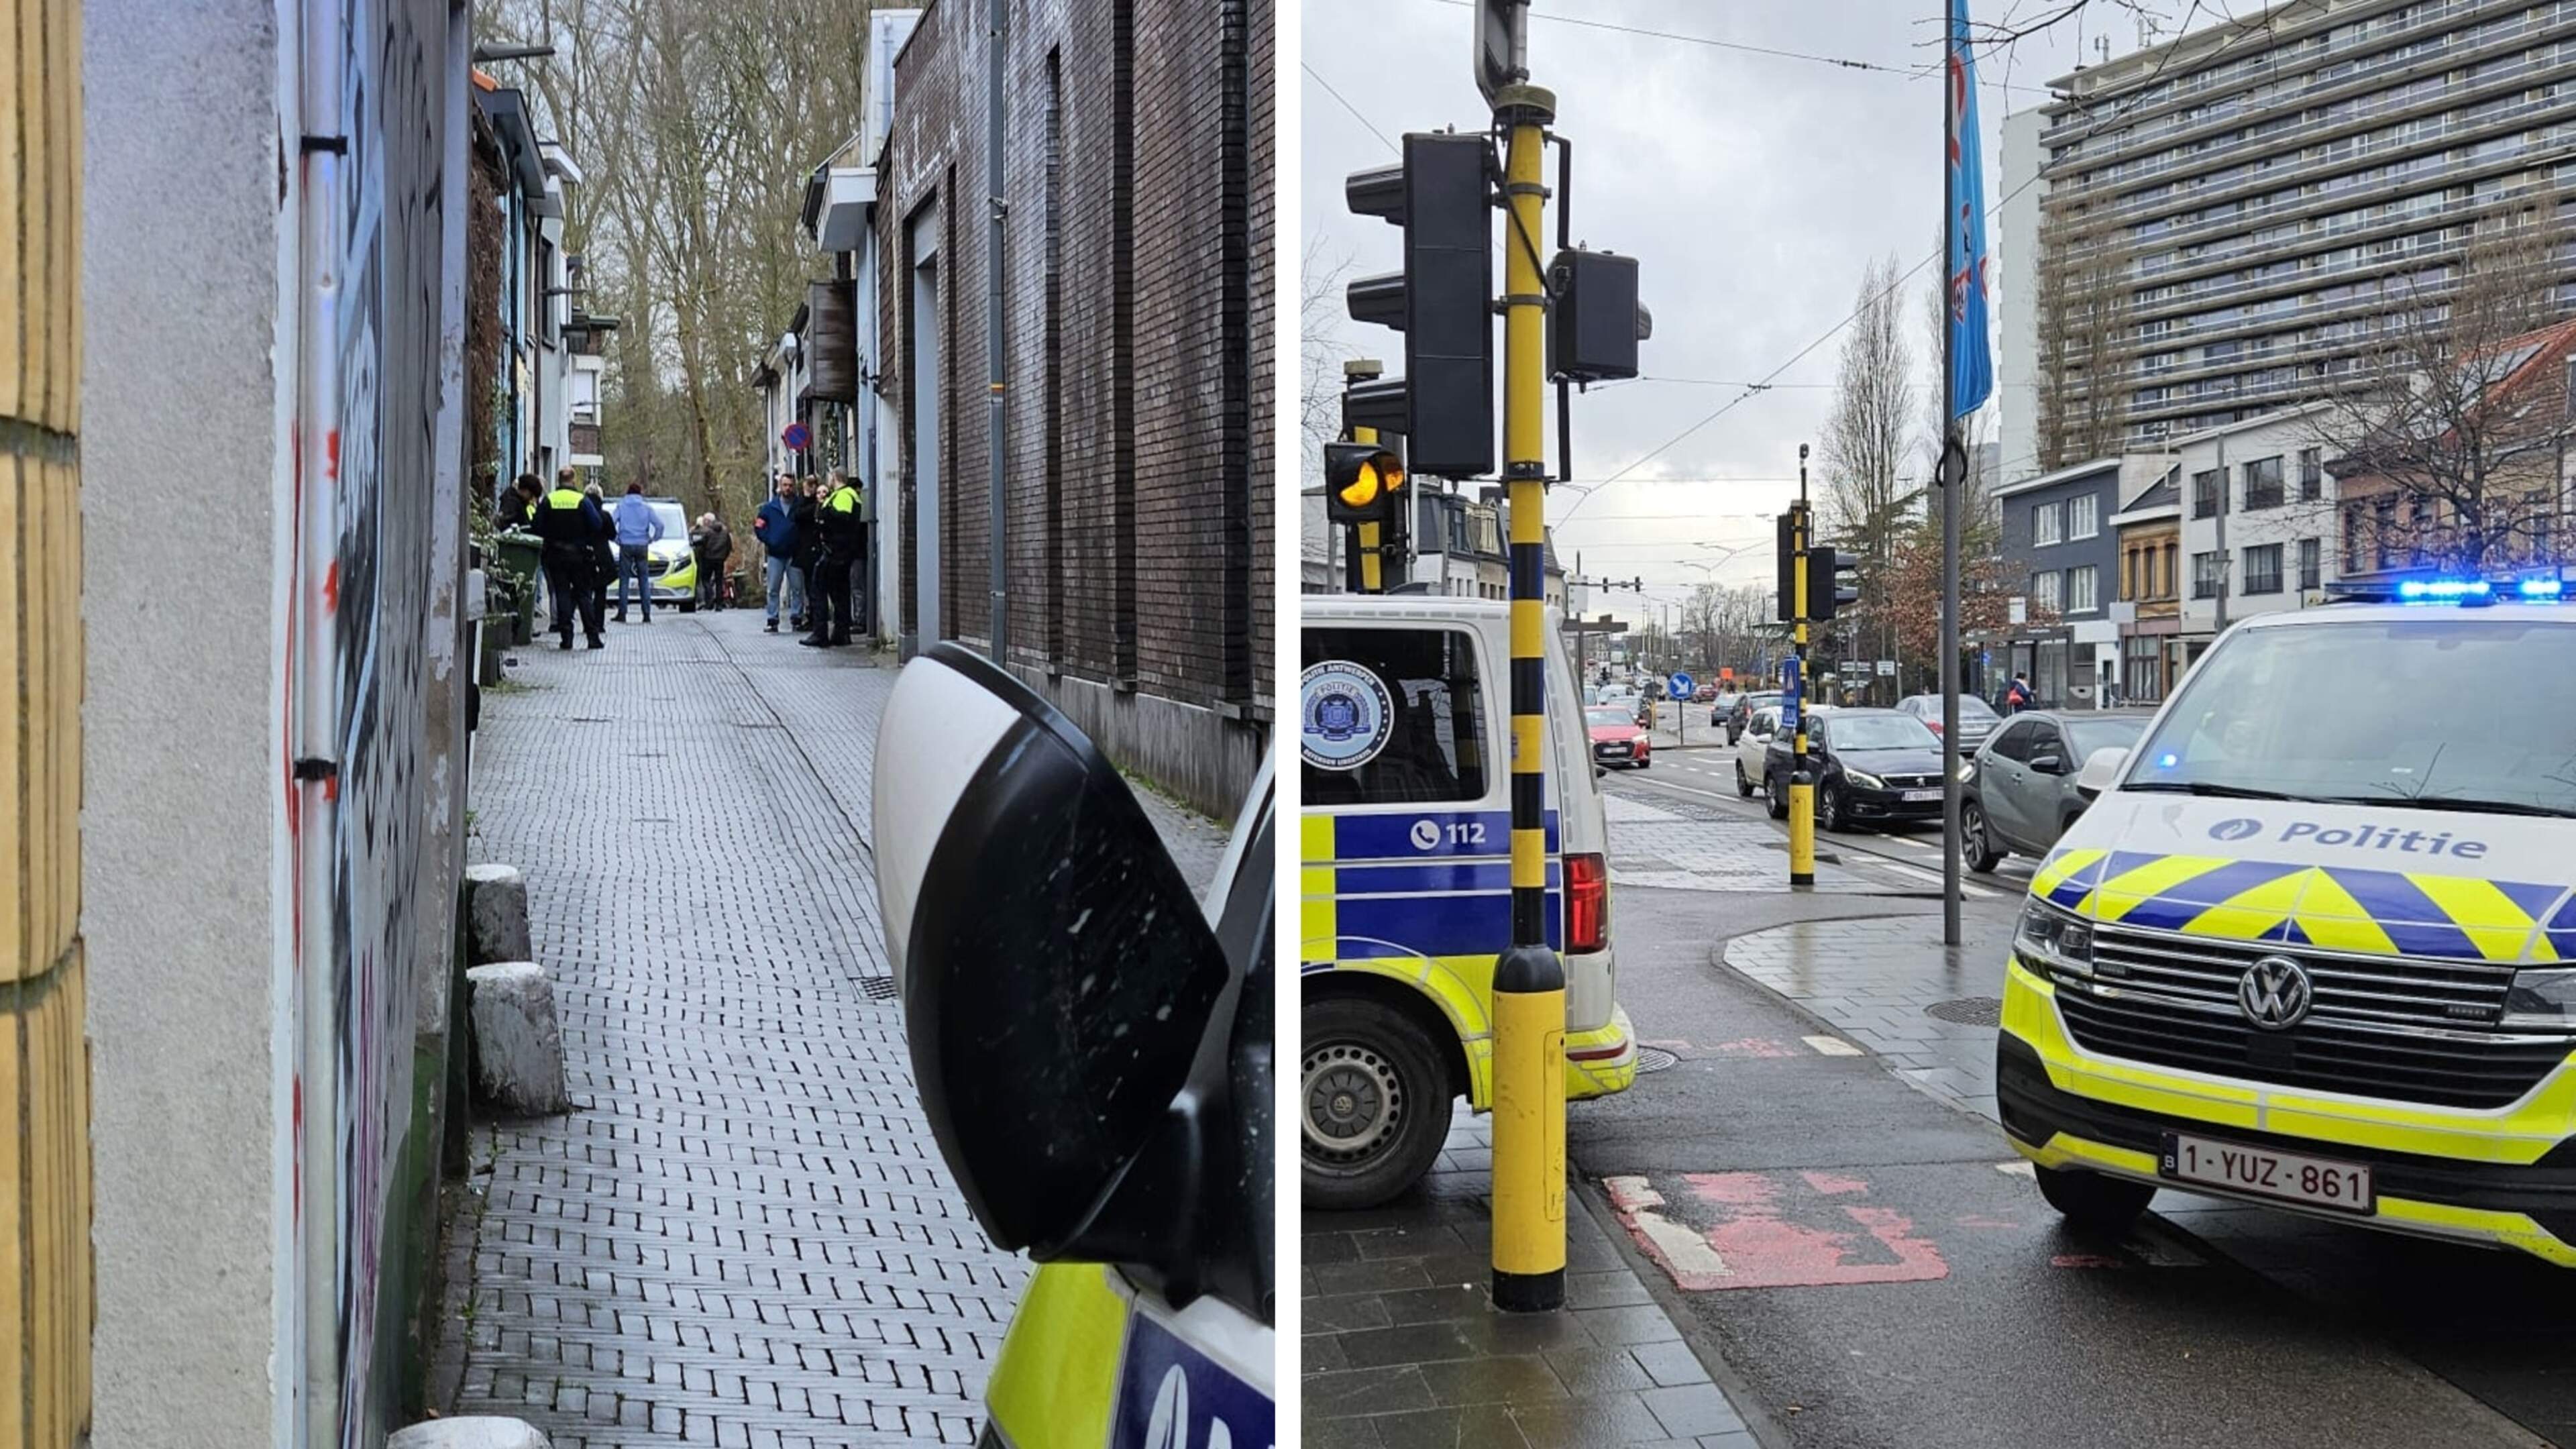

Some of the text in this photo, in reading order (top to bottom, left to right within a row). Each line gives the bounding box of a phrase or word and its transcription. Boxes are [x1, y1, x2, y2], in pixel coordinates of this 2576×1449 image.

[1446, 822, 1486, 844] 112
[2279, 822, 2488, 859] Politie
[2164, 1144, 2359, 1201] B 1-YUZ-861
